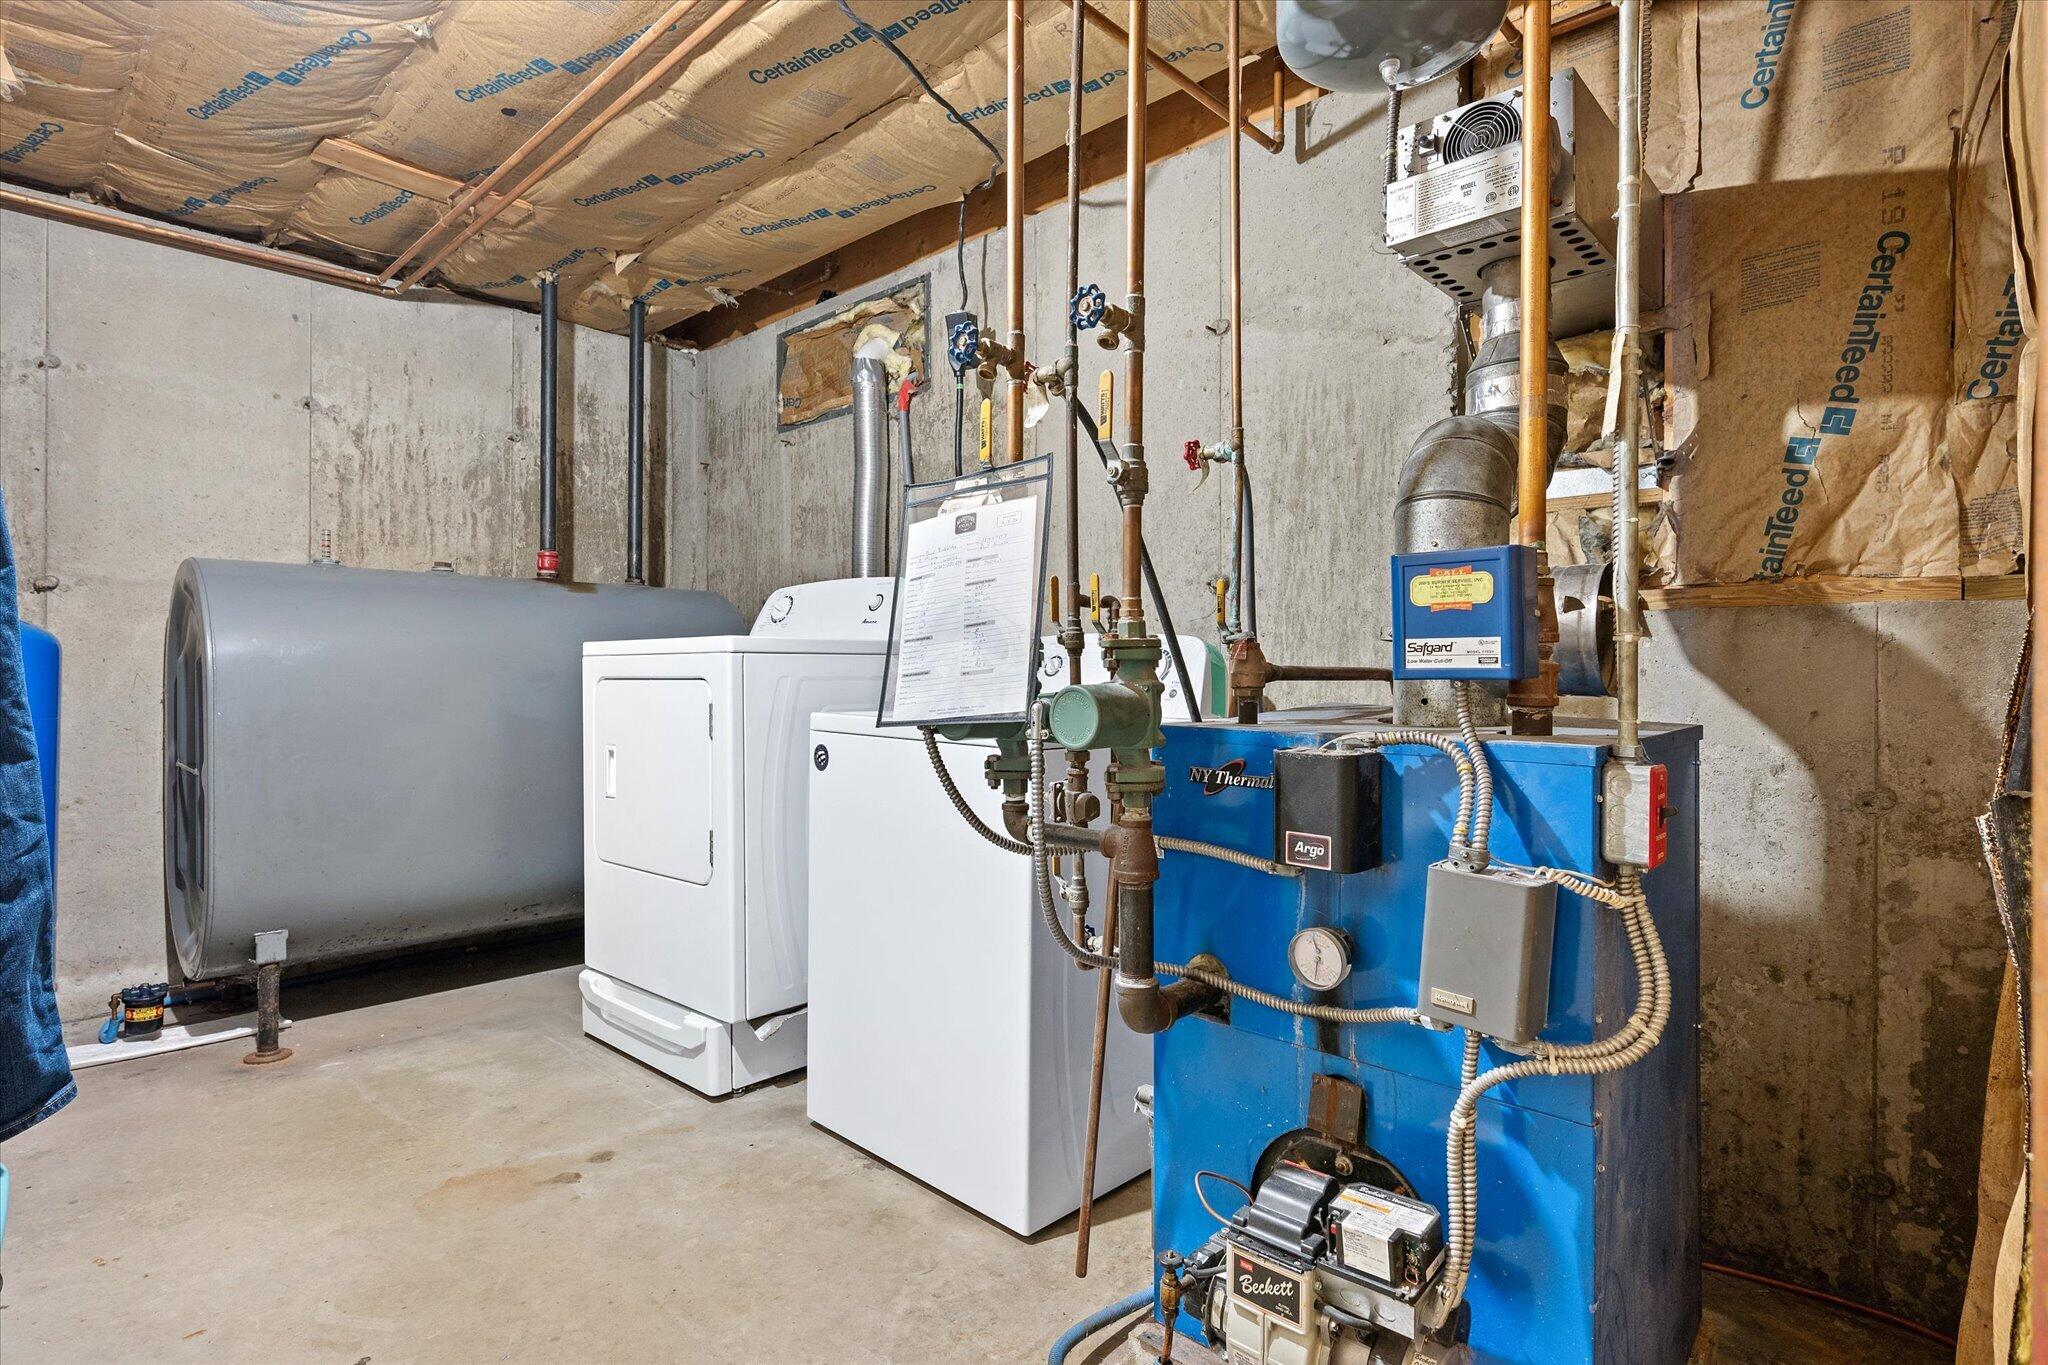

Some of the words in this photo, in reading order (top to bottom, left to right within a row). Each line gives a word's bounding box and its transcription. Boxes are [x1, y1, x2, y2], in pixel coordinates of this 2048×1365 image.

[288, 29, 372, 80] CertainTeed
[748, 34, 857, 84] CertainTeed
[454, 63, 539, 102] CertainTeed
[187, 78, 262, 120] CertainTeed
[946, 85, 1054, 124] Certaineed
[682, 149, 766, 183] CertainTeed
[574, 179, 646, 207] CertainTeed
[852, 184, 937, 215] CertainTeed
[740, 211, 817, 236] CertainTeed
[1829, 231, 1910, 403] CertainTeed
[1407, 642, 1453, 656] Safgard
[1189, 768, 1212, 783] NY
[1215, 770, 1275, 789] Thermal
[1295, 841, 1325, 857] Argo
[1239, 1274, 1294, 1296] Beckett
